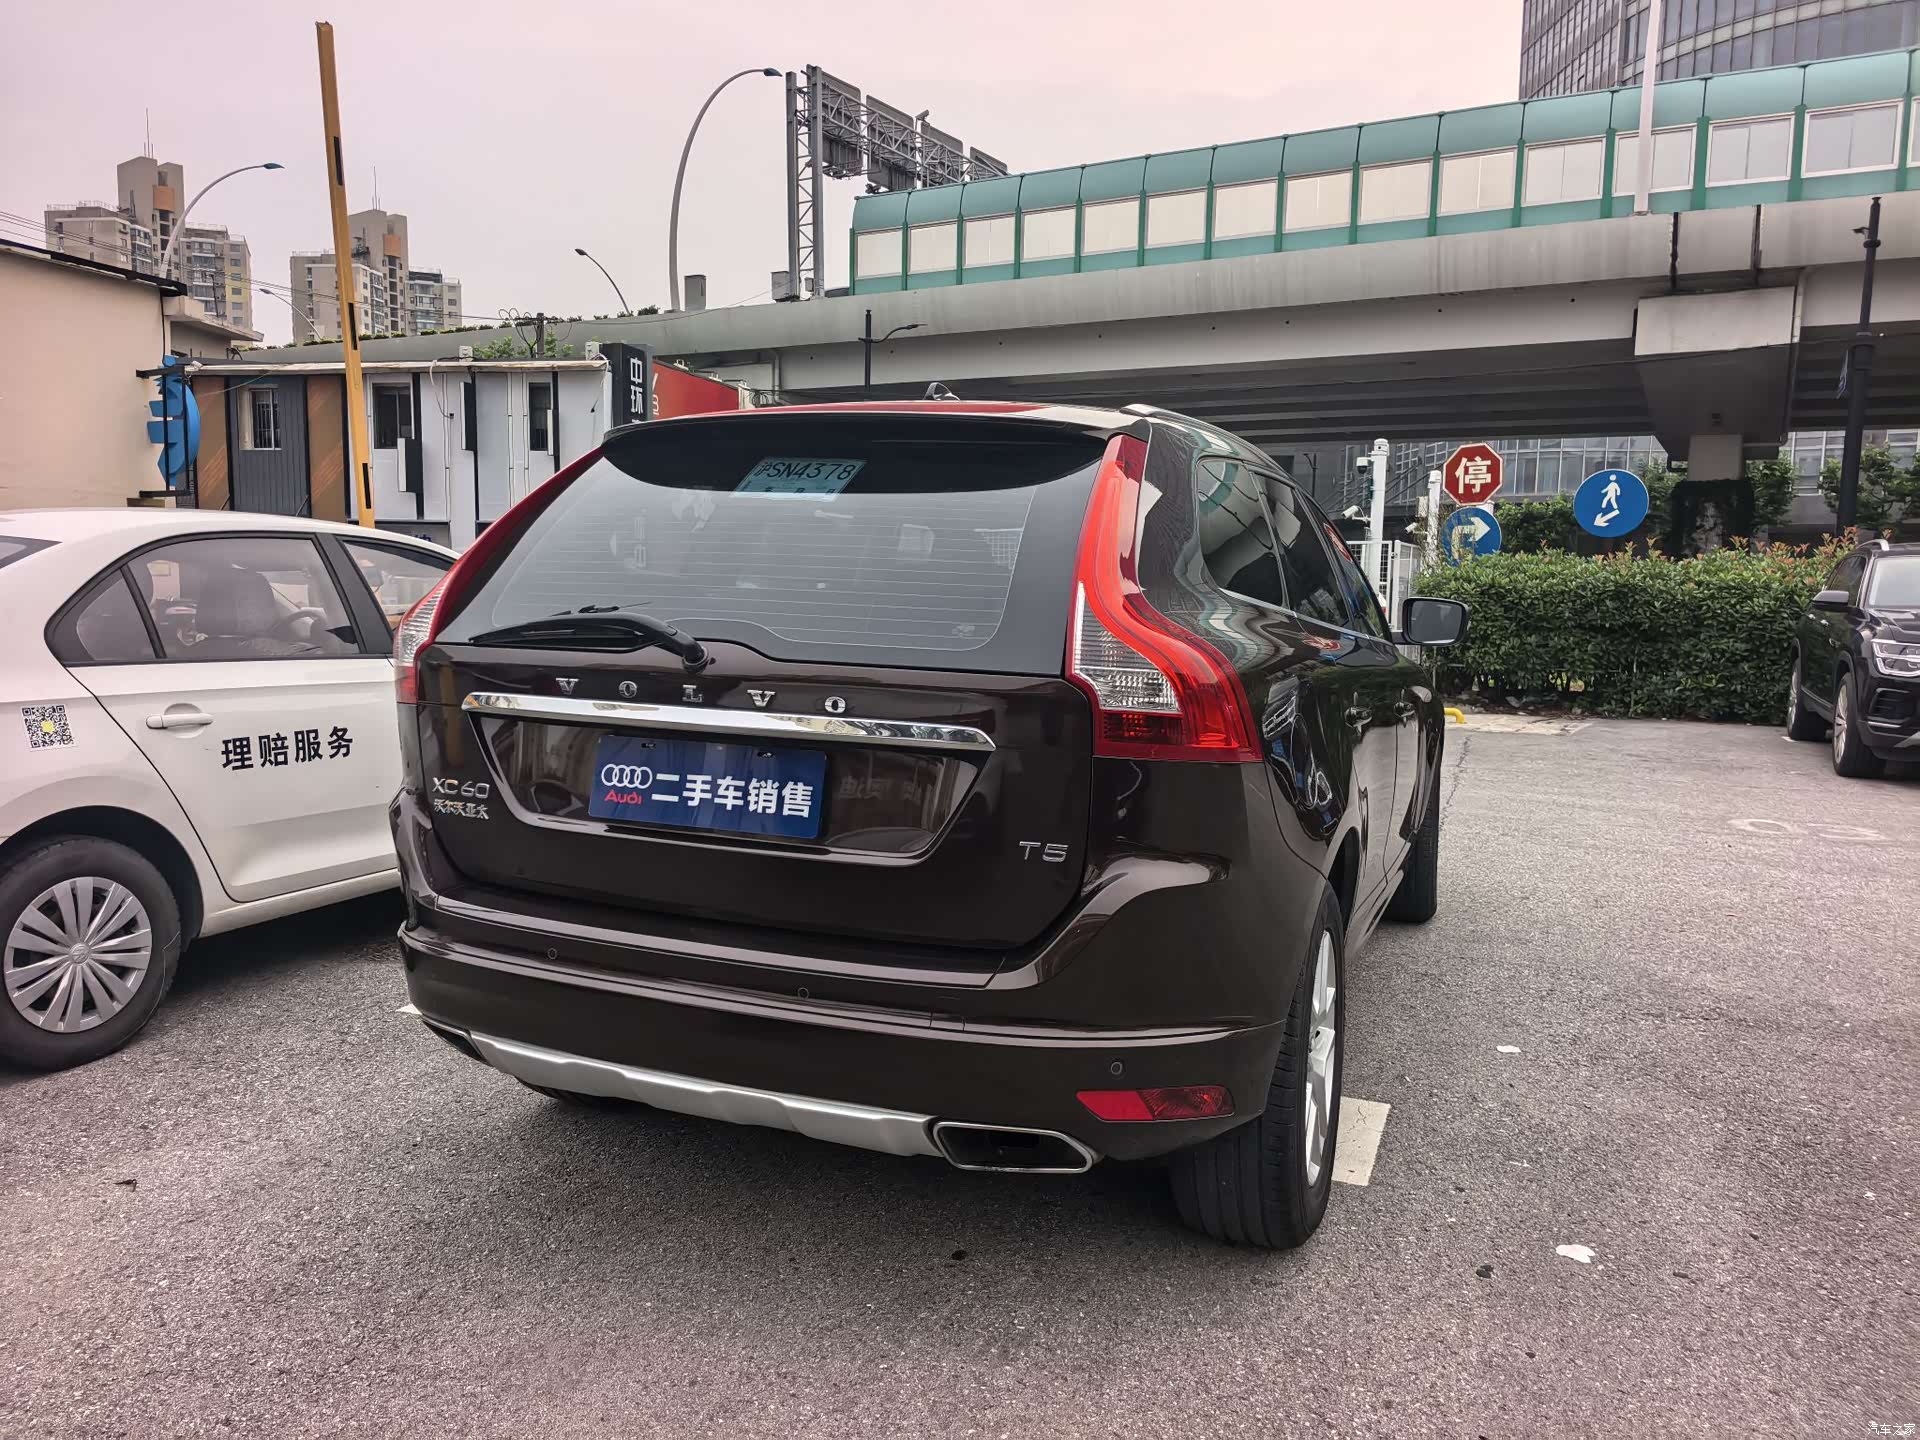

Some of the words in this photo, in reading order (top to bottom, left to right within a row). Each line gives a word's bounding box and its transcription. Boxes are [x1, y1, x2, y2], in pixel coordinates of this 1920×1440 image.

[630, 357, 644, 423] 中环
[1454, 455, 1492, 494] 停
[555, 677, 847, 714] VOLVO
[221, 726, 353, 771] 理赔服务
[433, 798, 490, 820] 沃尔沃亚太
[604, 789, 642, 805] Audi
[652, 773, 813, 818] 二手车销售
[1019, 841, 1069, 863] T5
